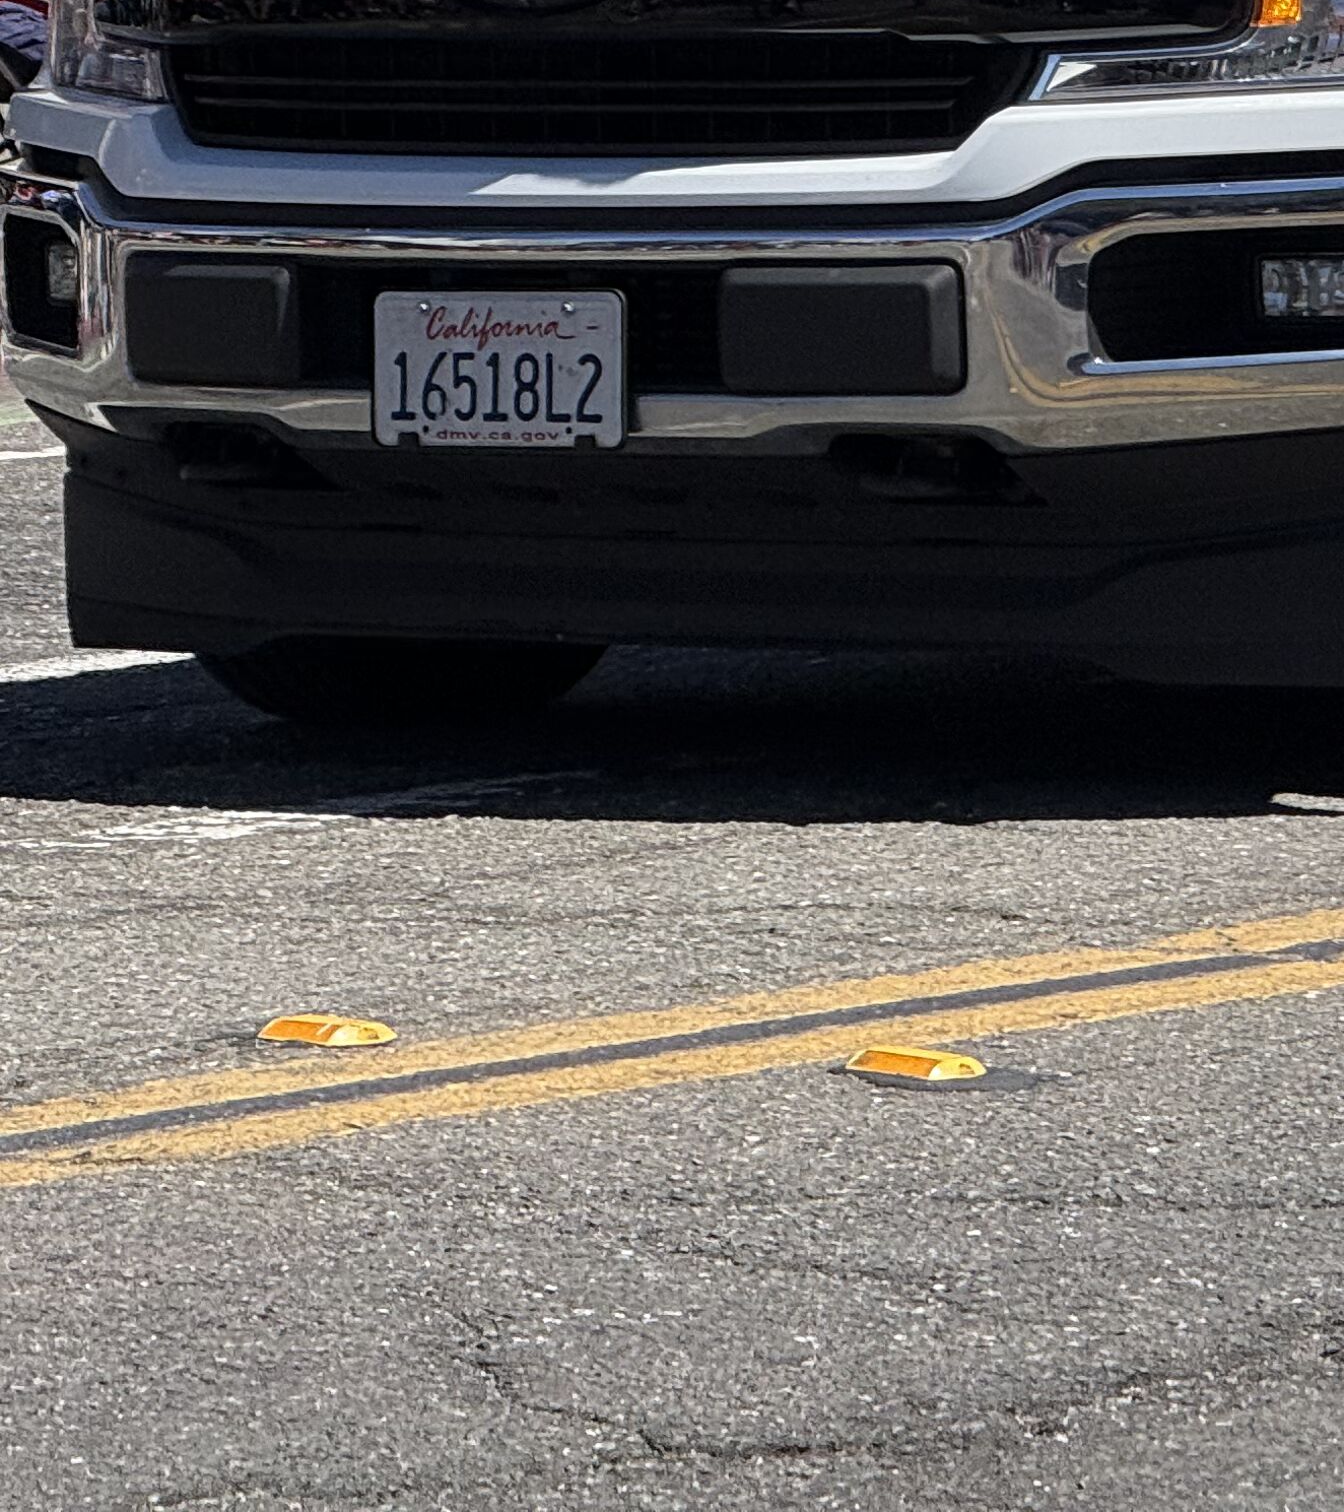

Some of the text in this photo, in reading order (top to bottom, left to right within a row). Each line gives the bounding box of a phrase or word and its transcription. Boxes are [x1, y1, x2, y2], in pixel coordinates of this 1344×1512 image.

[426, 305, 576, 350] California
[390, 351, 604, 423] 16518L2
[436, 429, 560, 442] dmv.ca.gov
